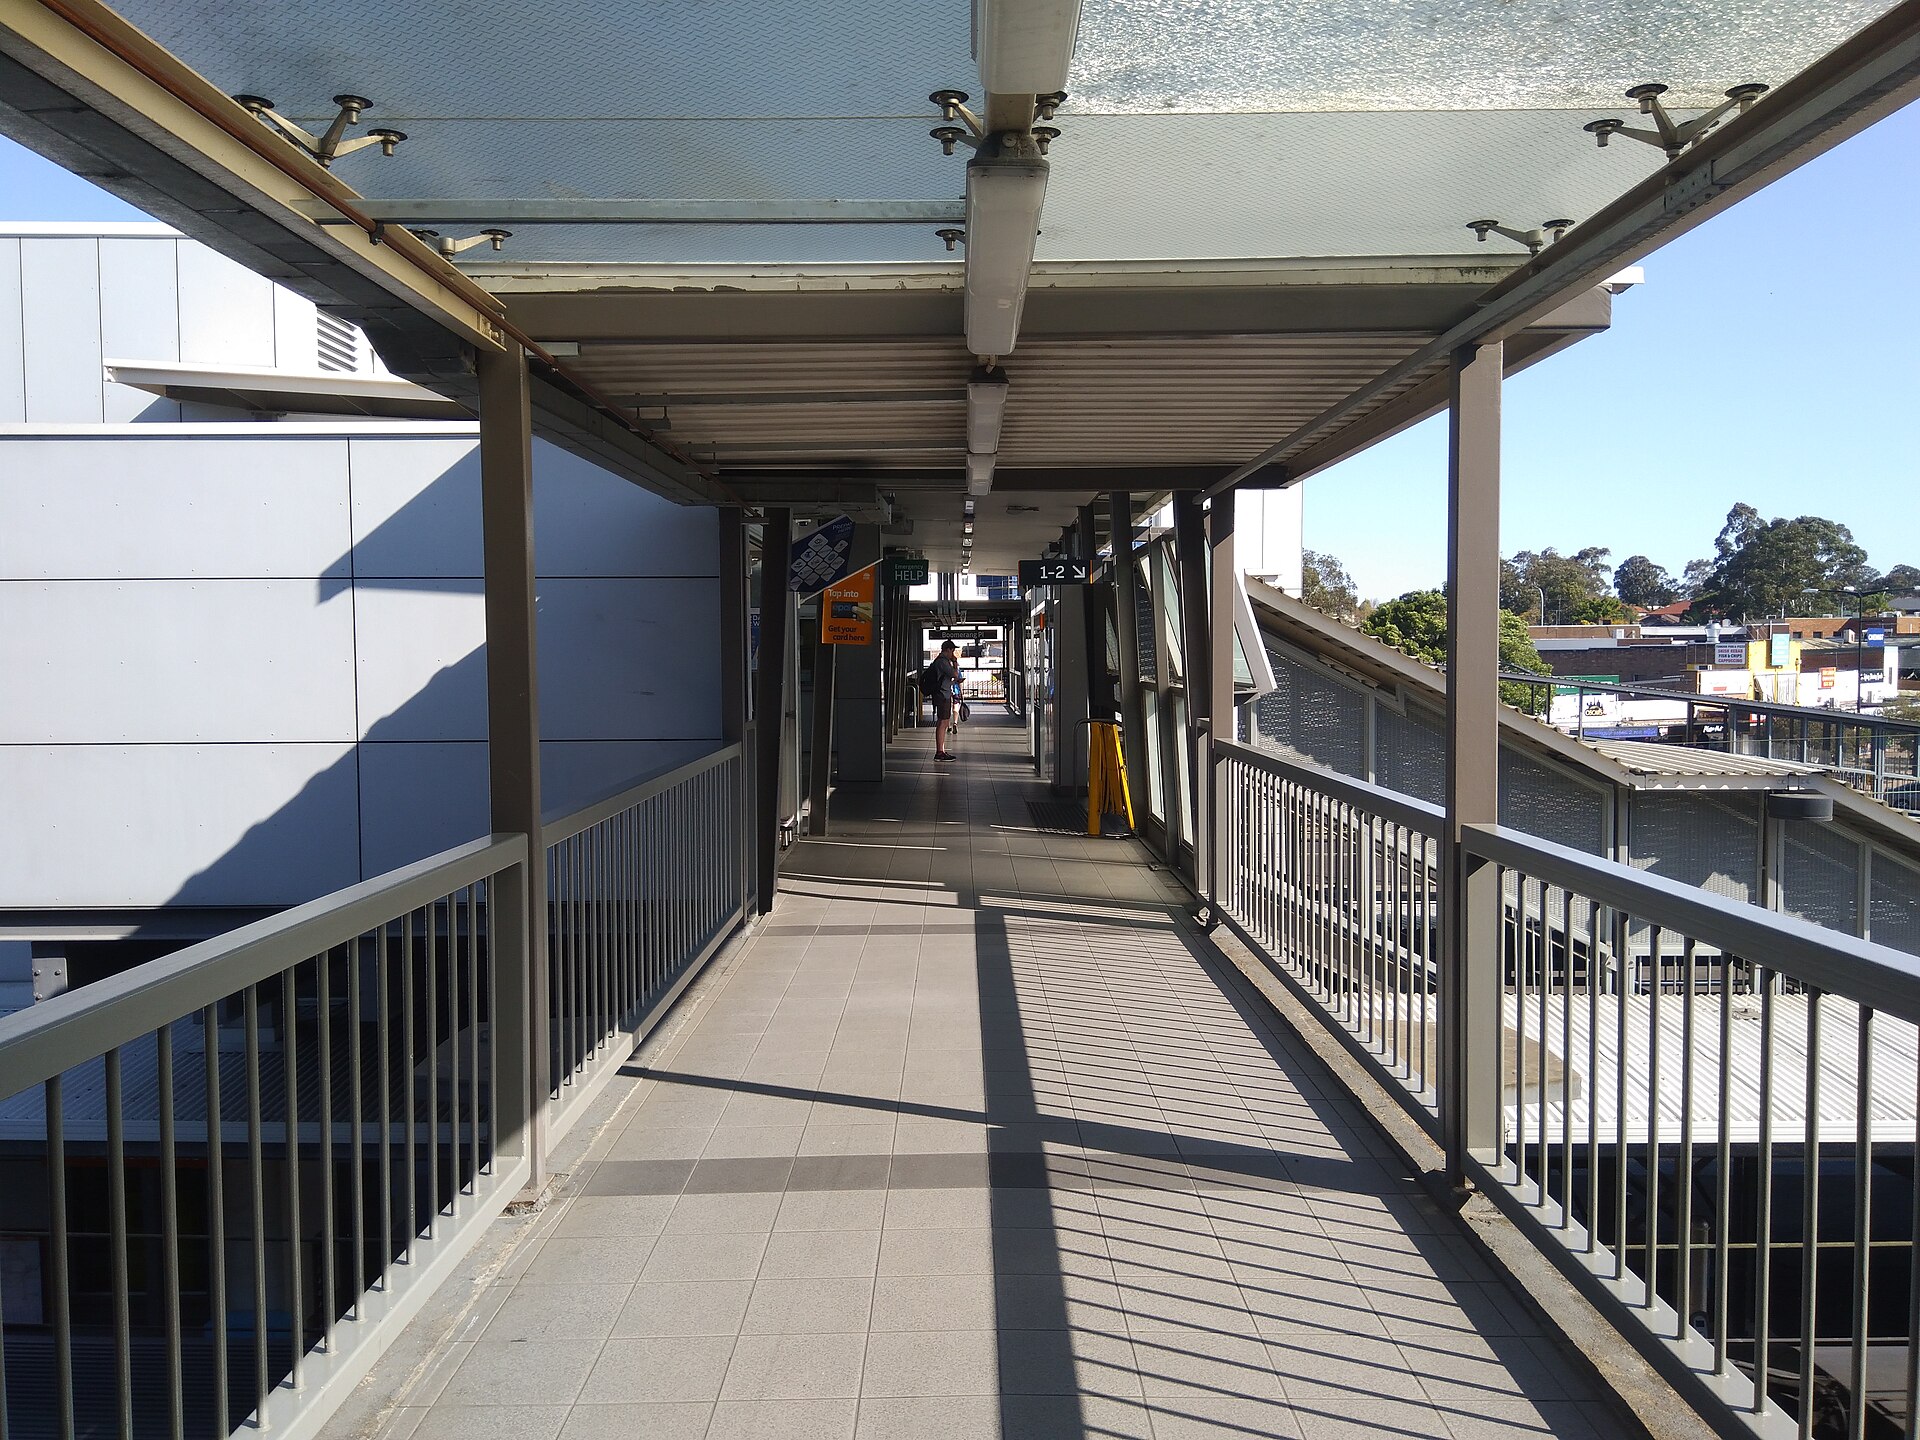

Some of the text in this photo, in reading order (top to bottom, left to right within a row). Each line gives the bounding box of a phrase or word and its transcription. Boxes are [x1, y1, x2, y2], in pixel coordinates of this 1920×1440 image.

[894, 570, 924, 581] HELP
[829, 589, 859, 599] Tap into
[828, 625, 857, 634] Get your
[941, 631, 978, 639] Boomerang
